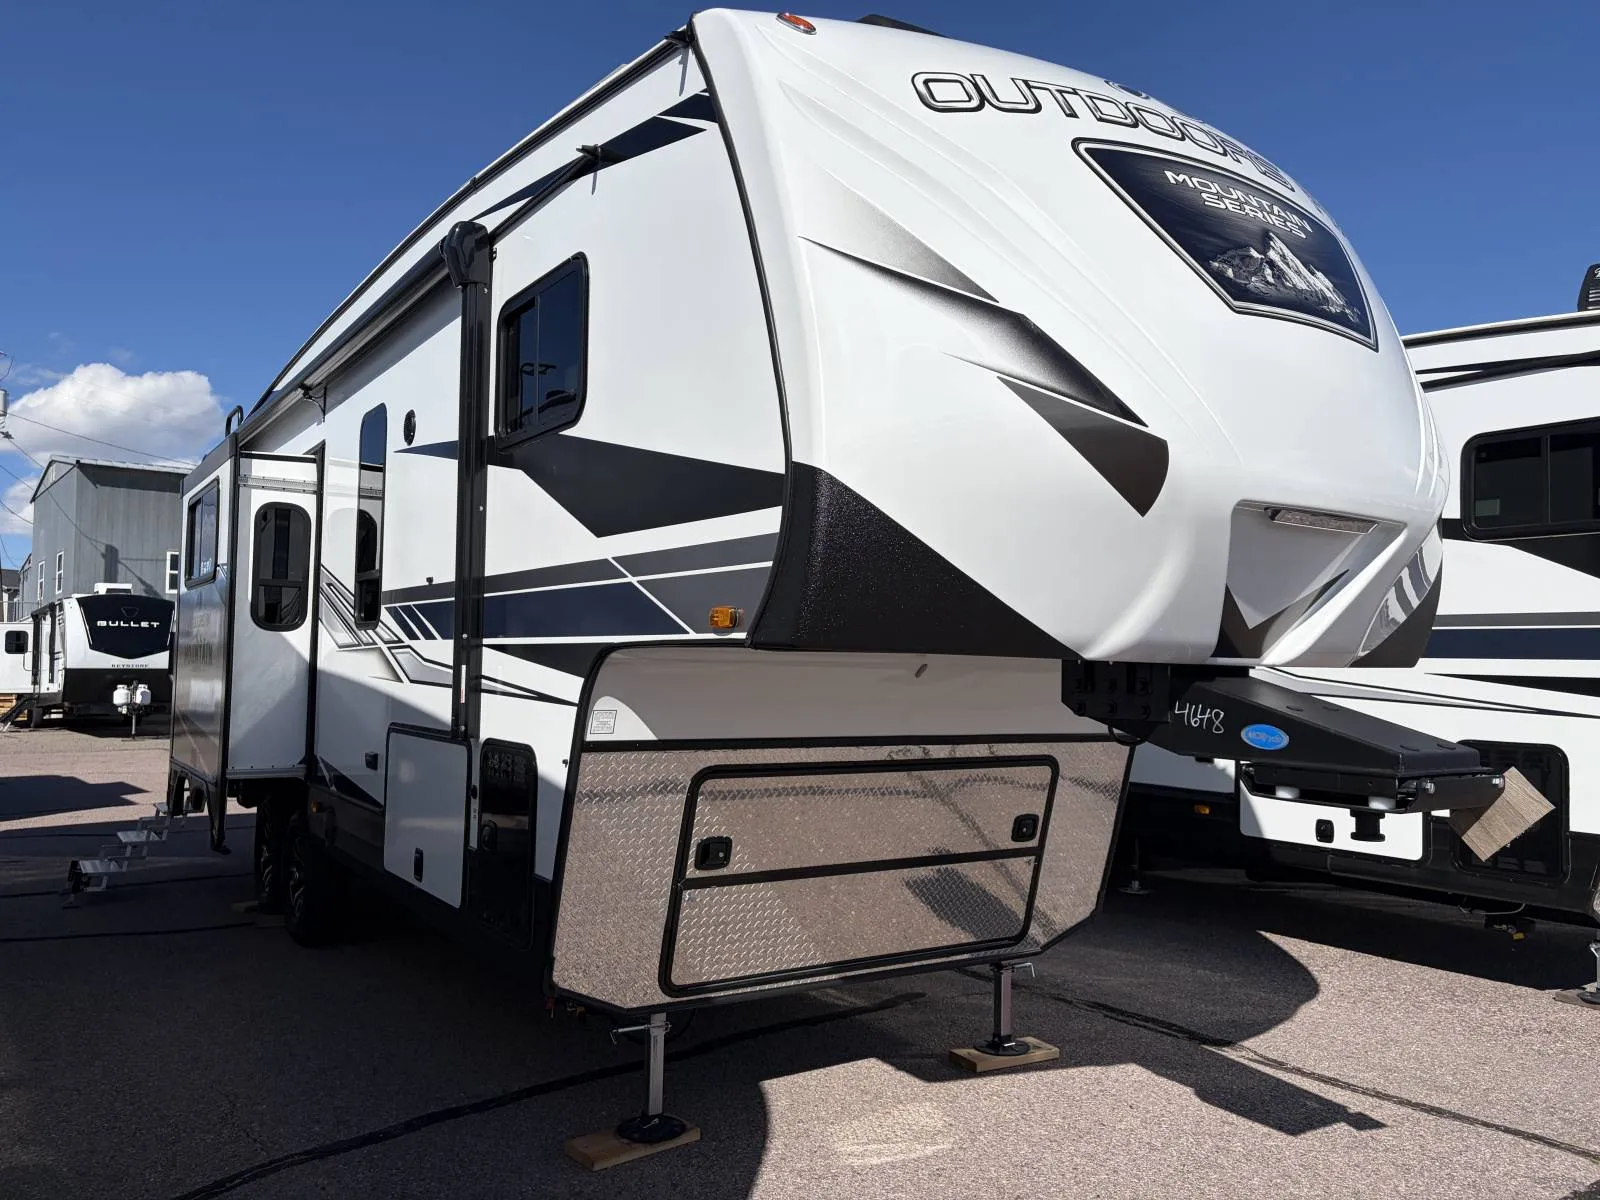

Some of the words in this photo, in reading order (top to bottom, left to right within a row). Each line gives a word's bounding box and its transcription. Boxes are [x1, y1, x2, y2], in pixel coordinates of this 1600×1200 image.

[911, 72, 1295, 192] OUTDOORS
[1165, 170, 1312, 233] MOUNTAIN
[1202, 192, 1306, 239] SERIES
[97, 620, 160, 628] BULLET
[1175, 700, 1224, 733] 4648
